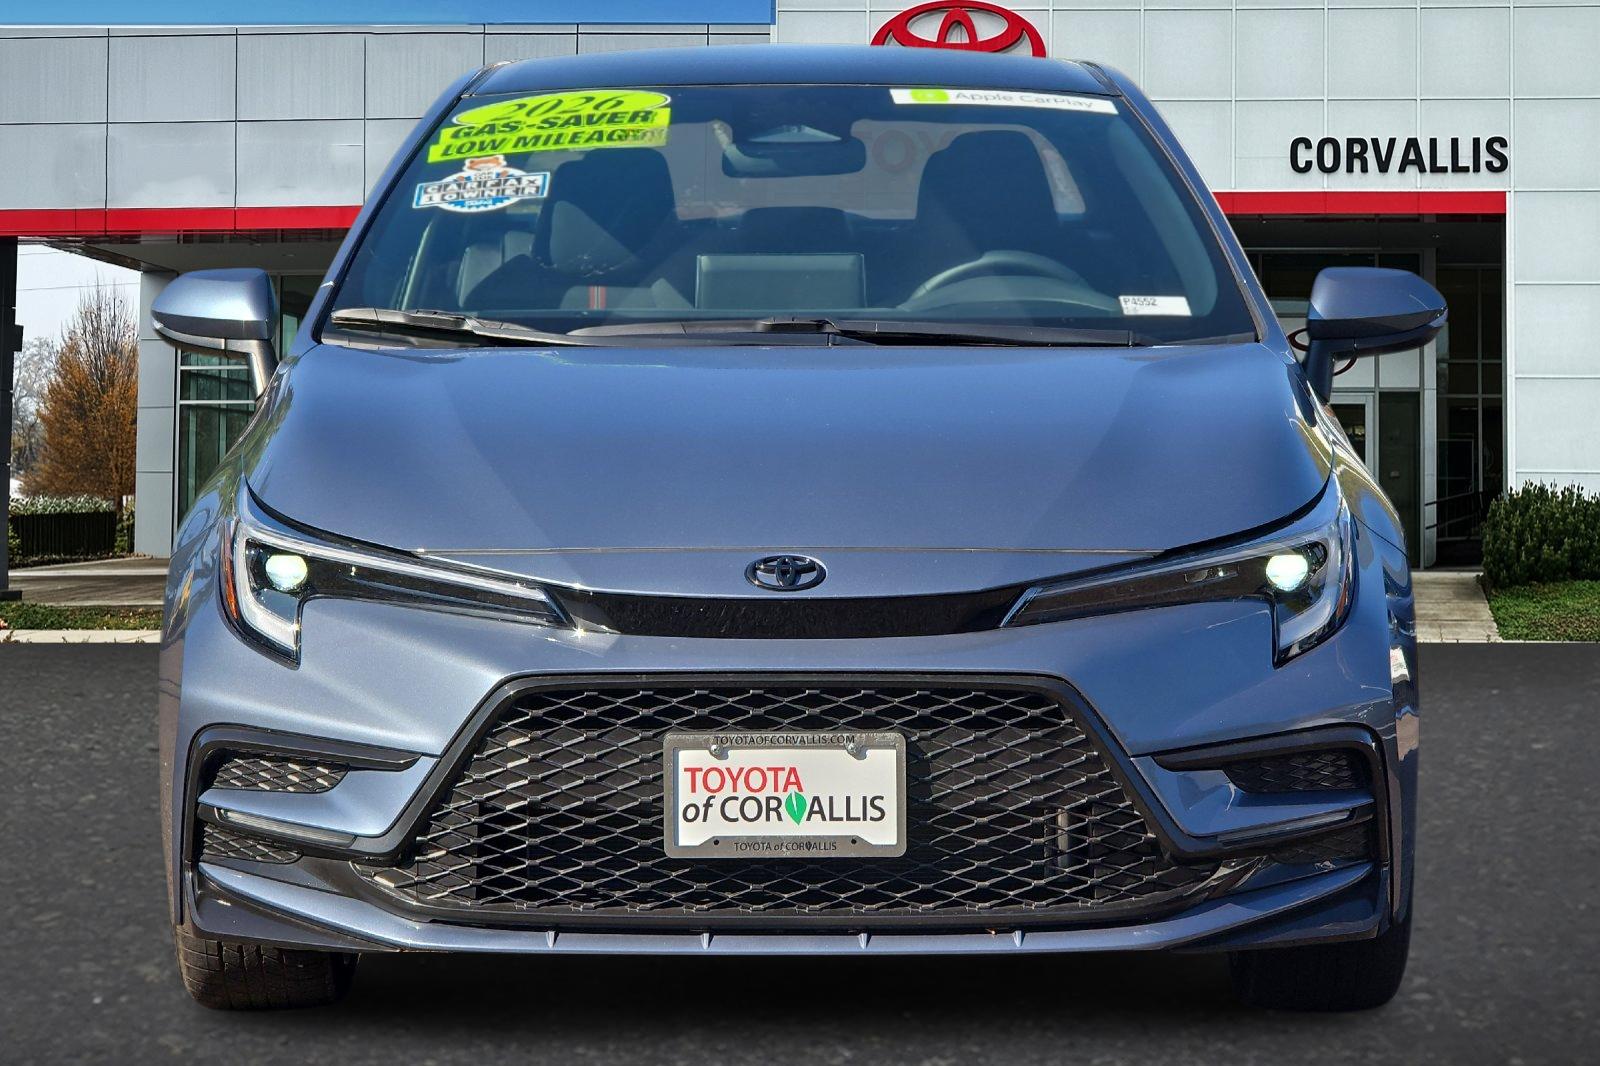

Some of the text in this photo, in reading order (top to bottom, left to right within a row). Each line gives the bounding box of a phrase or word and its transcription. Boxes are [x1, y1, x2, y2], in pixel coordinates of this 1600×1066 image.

[490, 95, 629, 121] 2026
[955, 91, 1095, 109] Apple CarPlay
[451, 110, 657, 138] GAS-SAVER
[441, 138, 505, 157] LOW
[1289, 136, 1509, 174] CORVALLIS
[424, 176, 539, 194] CARFAX
[713, 734, 856, 745] TOYOTAOFCORVALLIS.COM
[683, 766, 804, 794] TOYOTA
[682, 795, 716, 823] of
[734, 842, 772, 851] TOYOTA
[774, 842, 784, 851] of
